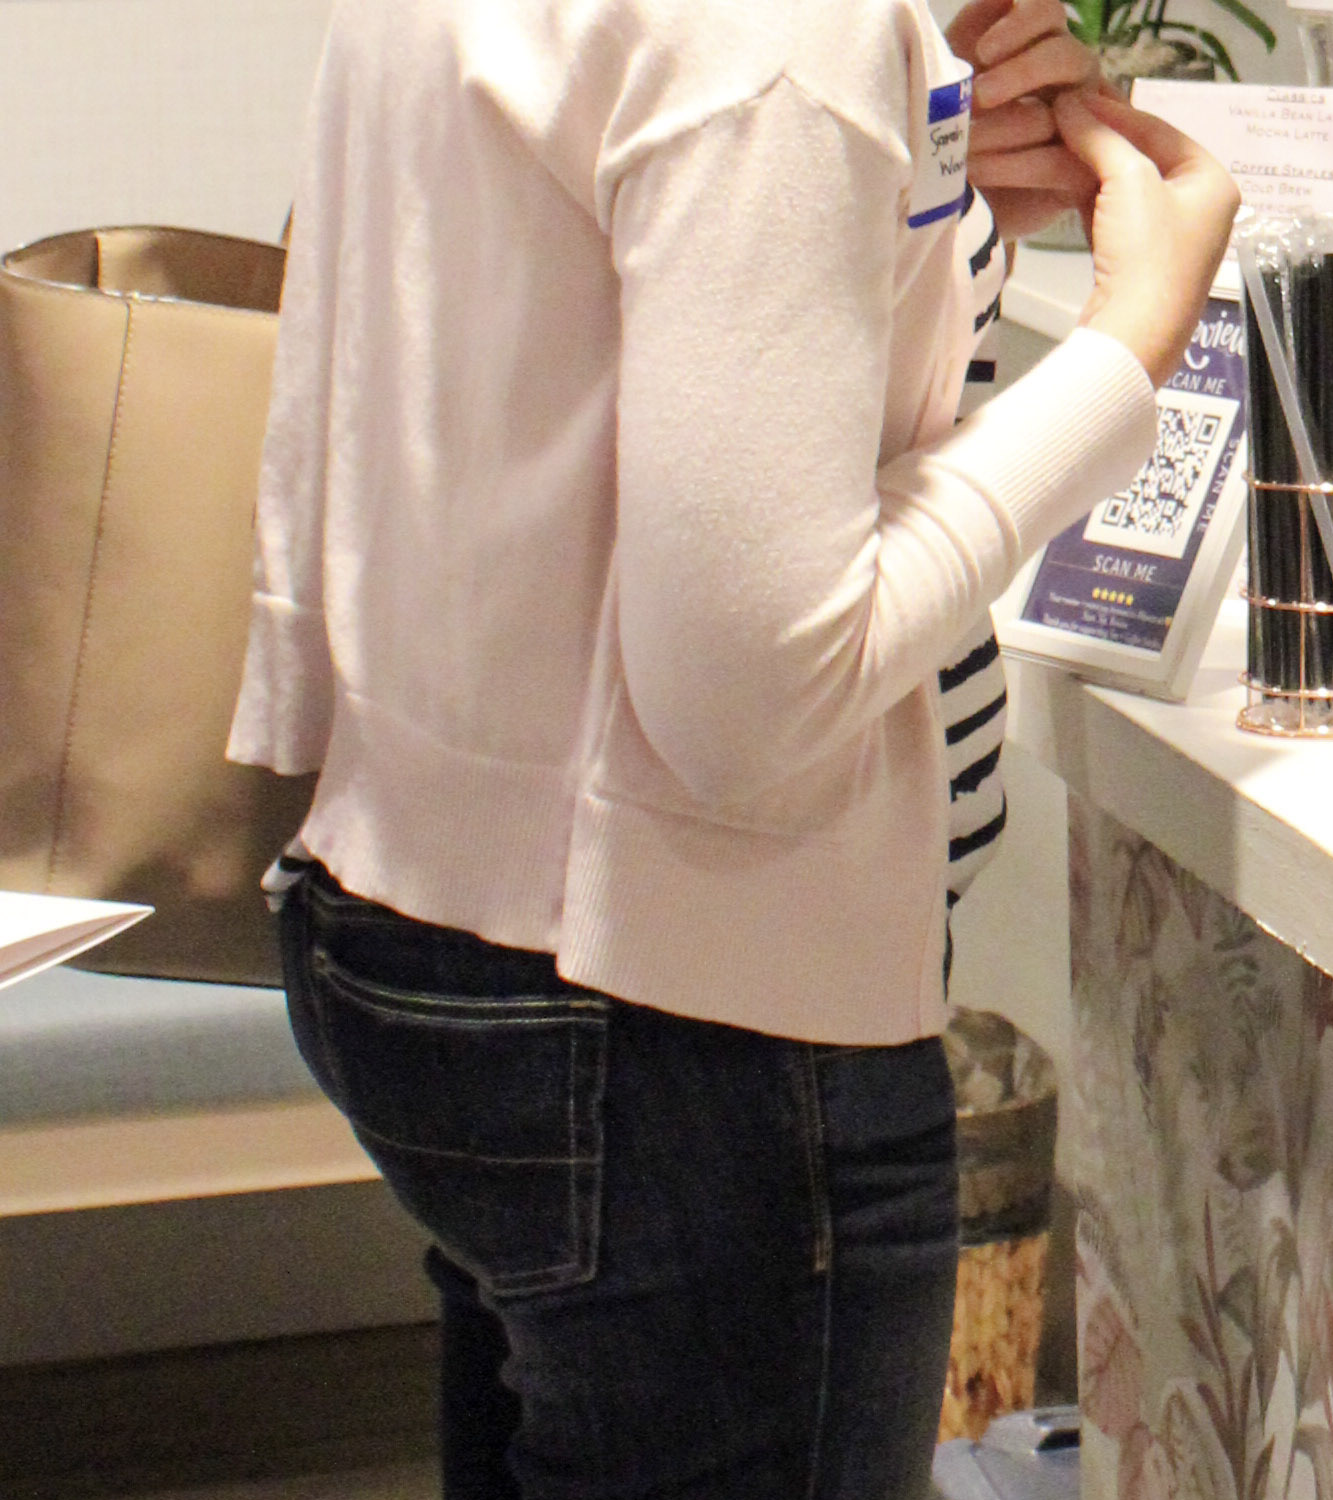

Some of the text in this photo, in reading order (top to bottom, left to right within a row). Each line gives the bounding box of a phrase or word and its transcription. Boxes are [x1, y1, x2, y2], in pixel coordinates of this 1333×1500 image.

[1281, 108, 1313, 121] BEAN
[1246, 124, 1330, 142] MOCHA LATTE
[1230, 160, 1278, 176] COFFEE
[1240, 180, 1312, 196] COLD BREW
[1203, 376, 1227, 396] ME
[1091, 554, 1158, 582] SCAN ME
